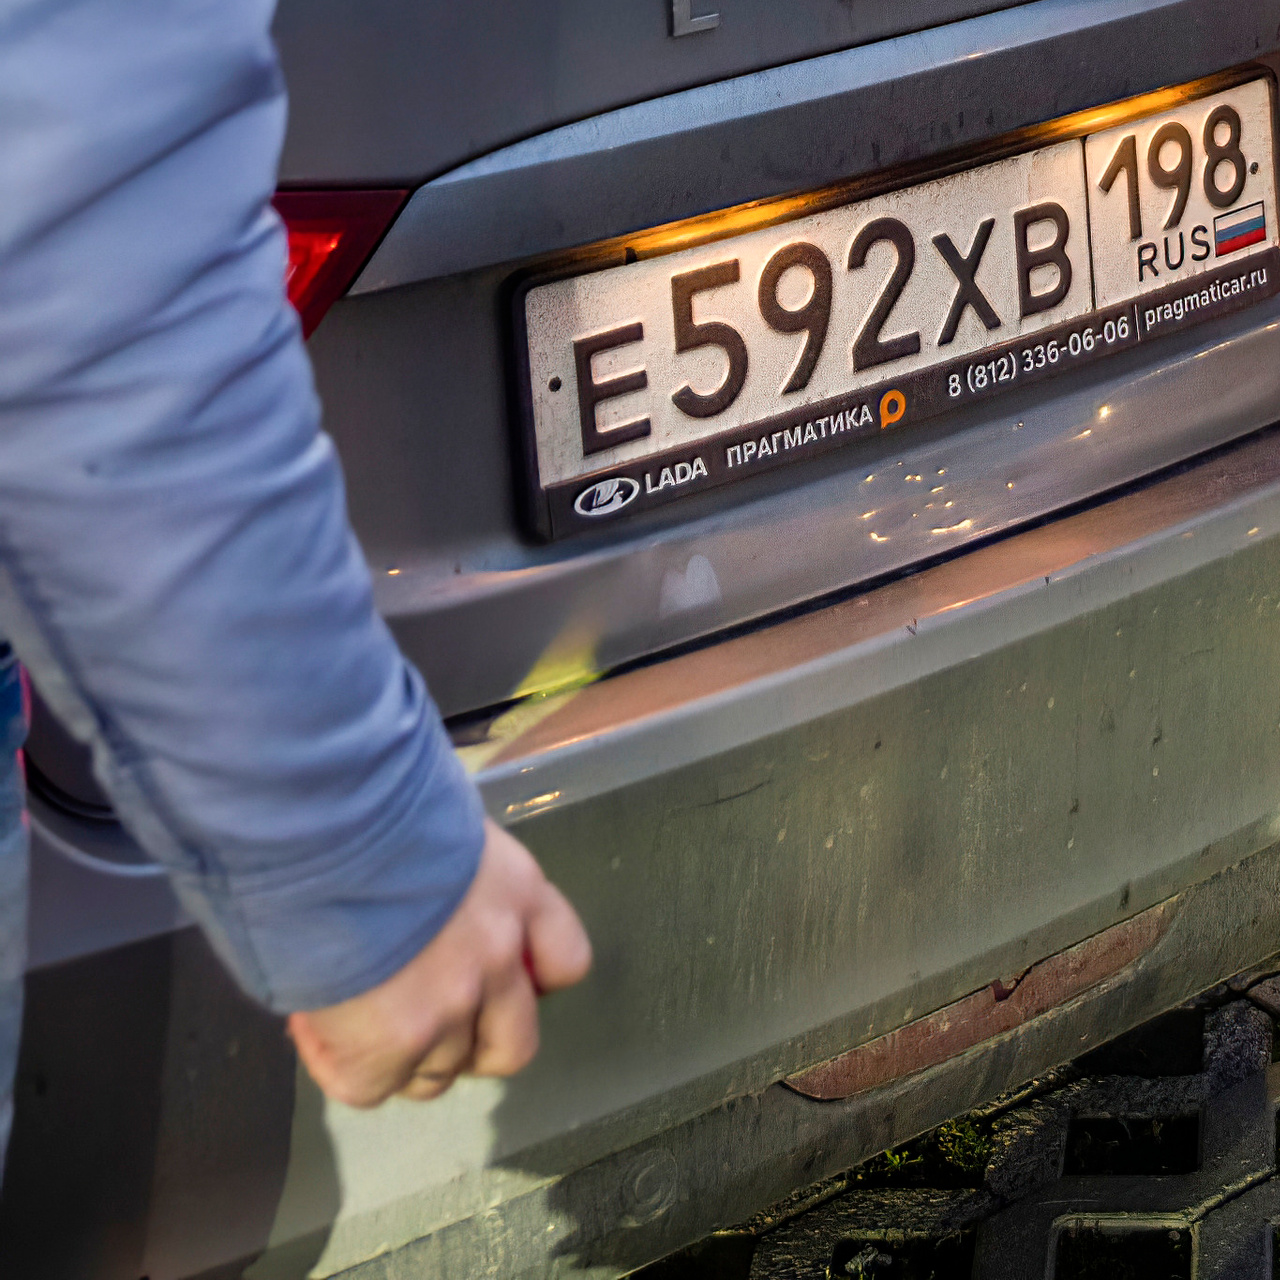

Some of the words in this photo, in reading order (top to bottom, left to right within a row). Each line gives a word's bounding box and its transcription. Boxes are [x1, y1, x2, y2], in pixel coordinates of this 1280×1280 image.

[572, 201, 1073, 457] Е592ХВ
[1098, 103, 1247, 243] 198
[1137, 224, 1211, 282] RUS
[645, 456, 708, 495] LADA
[726, 403, 874, 468] ПРАГМАТИКА
[948, 373, 962, 397] 8
[967, 351, 1017, 393] (812)
[1023, 315, 1130, 372] 336-06-06
[1144, 266, 1268, 331] pragmaticar.ru
